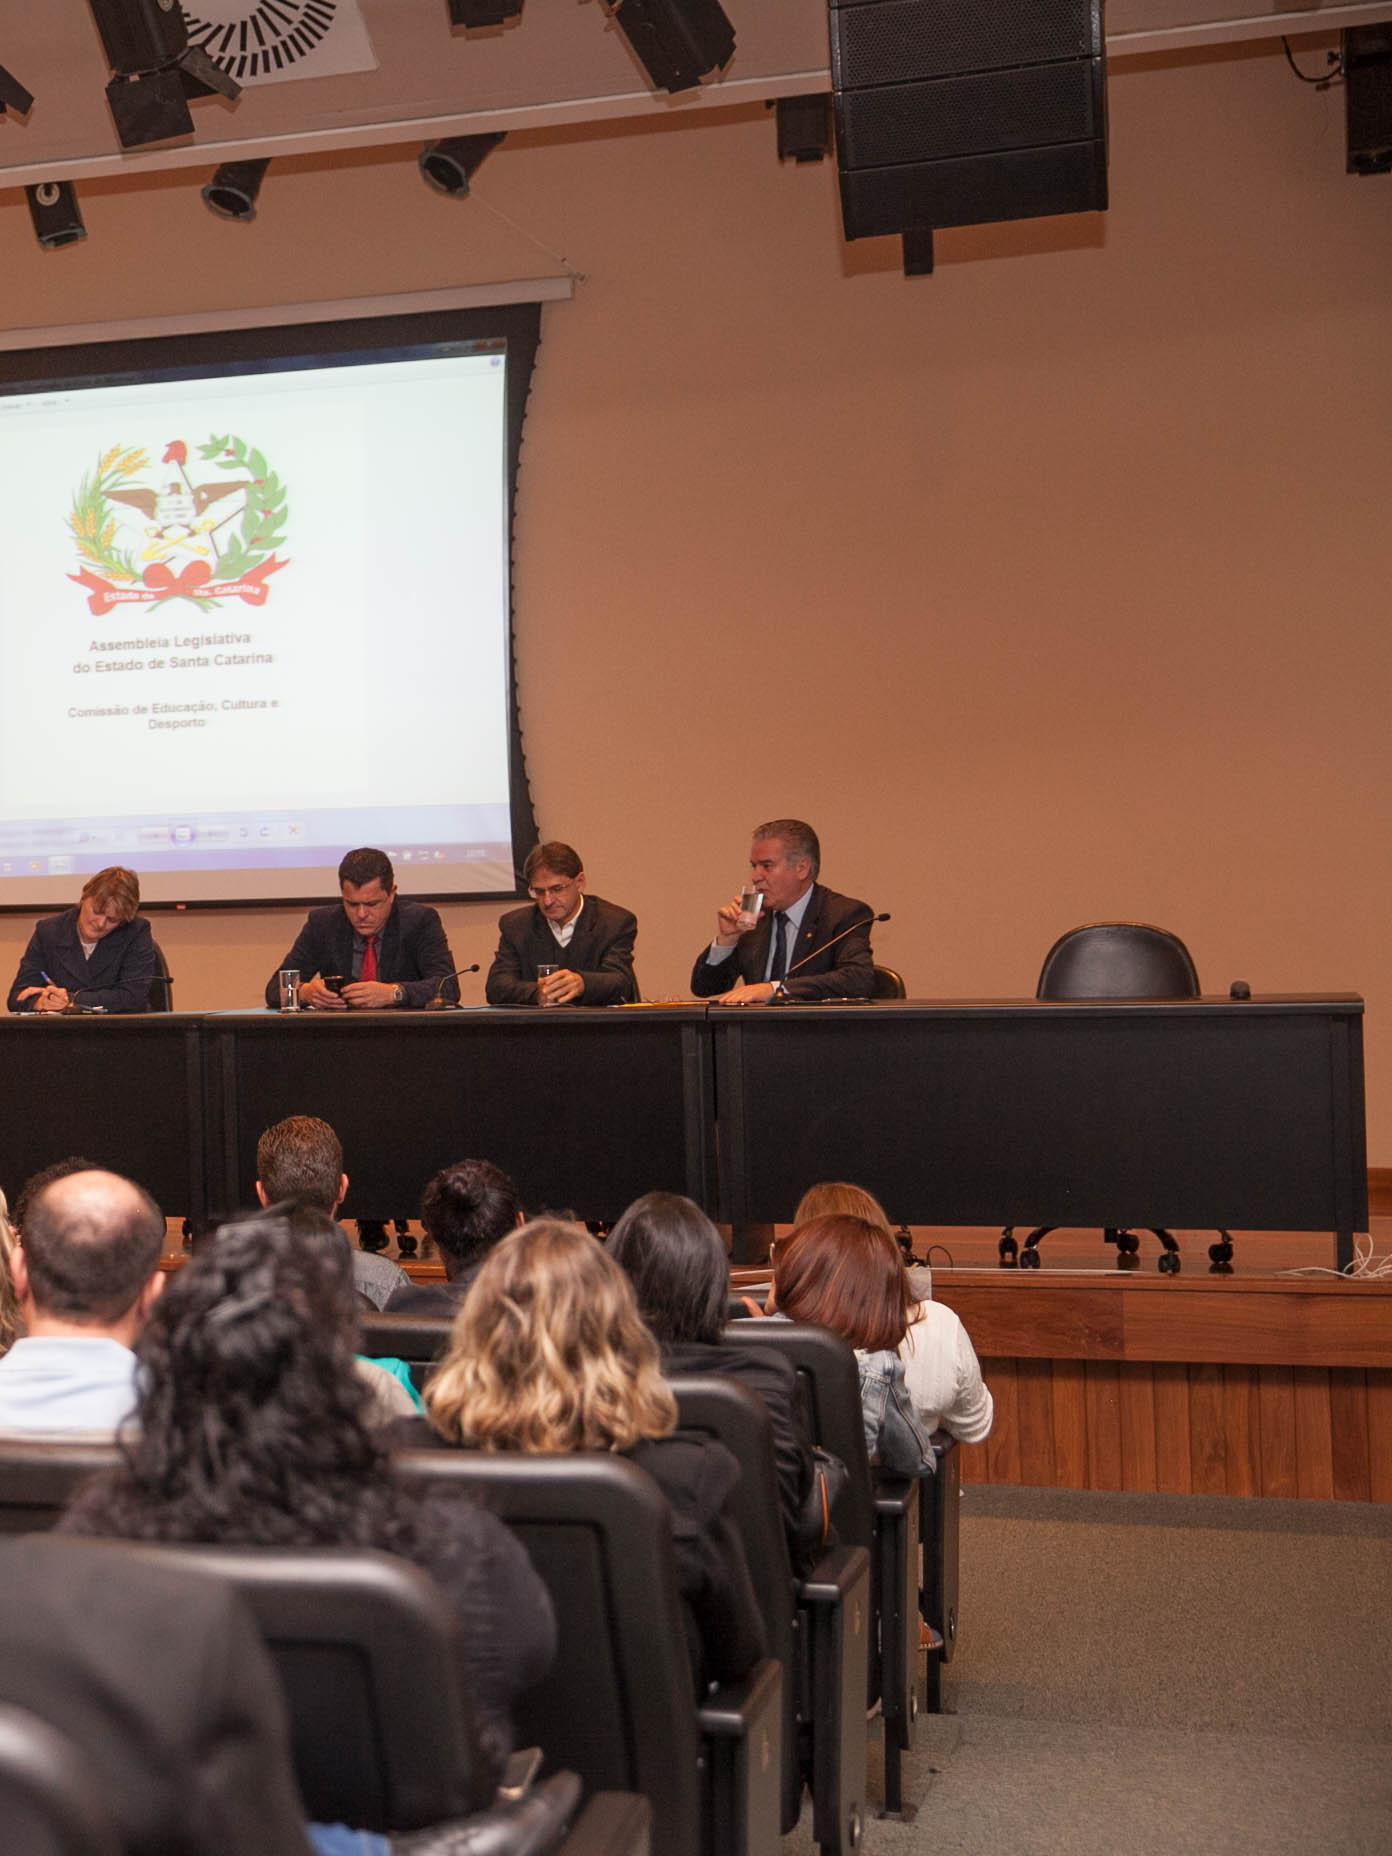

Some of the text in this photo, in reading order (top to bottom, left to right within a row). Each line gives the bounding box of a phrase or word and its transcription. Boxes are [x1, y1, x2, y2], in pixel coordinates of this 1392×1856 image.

[89, 632, 251, 652] Assembleia Legislativa
[73, 652, 274, 674] do Estado de Santa Catarina
[67, 698, 280, 719] Comissão de Educação, Cultura e
[148, 718, 206, 731] Desporto
